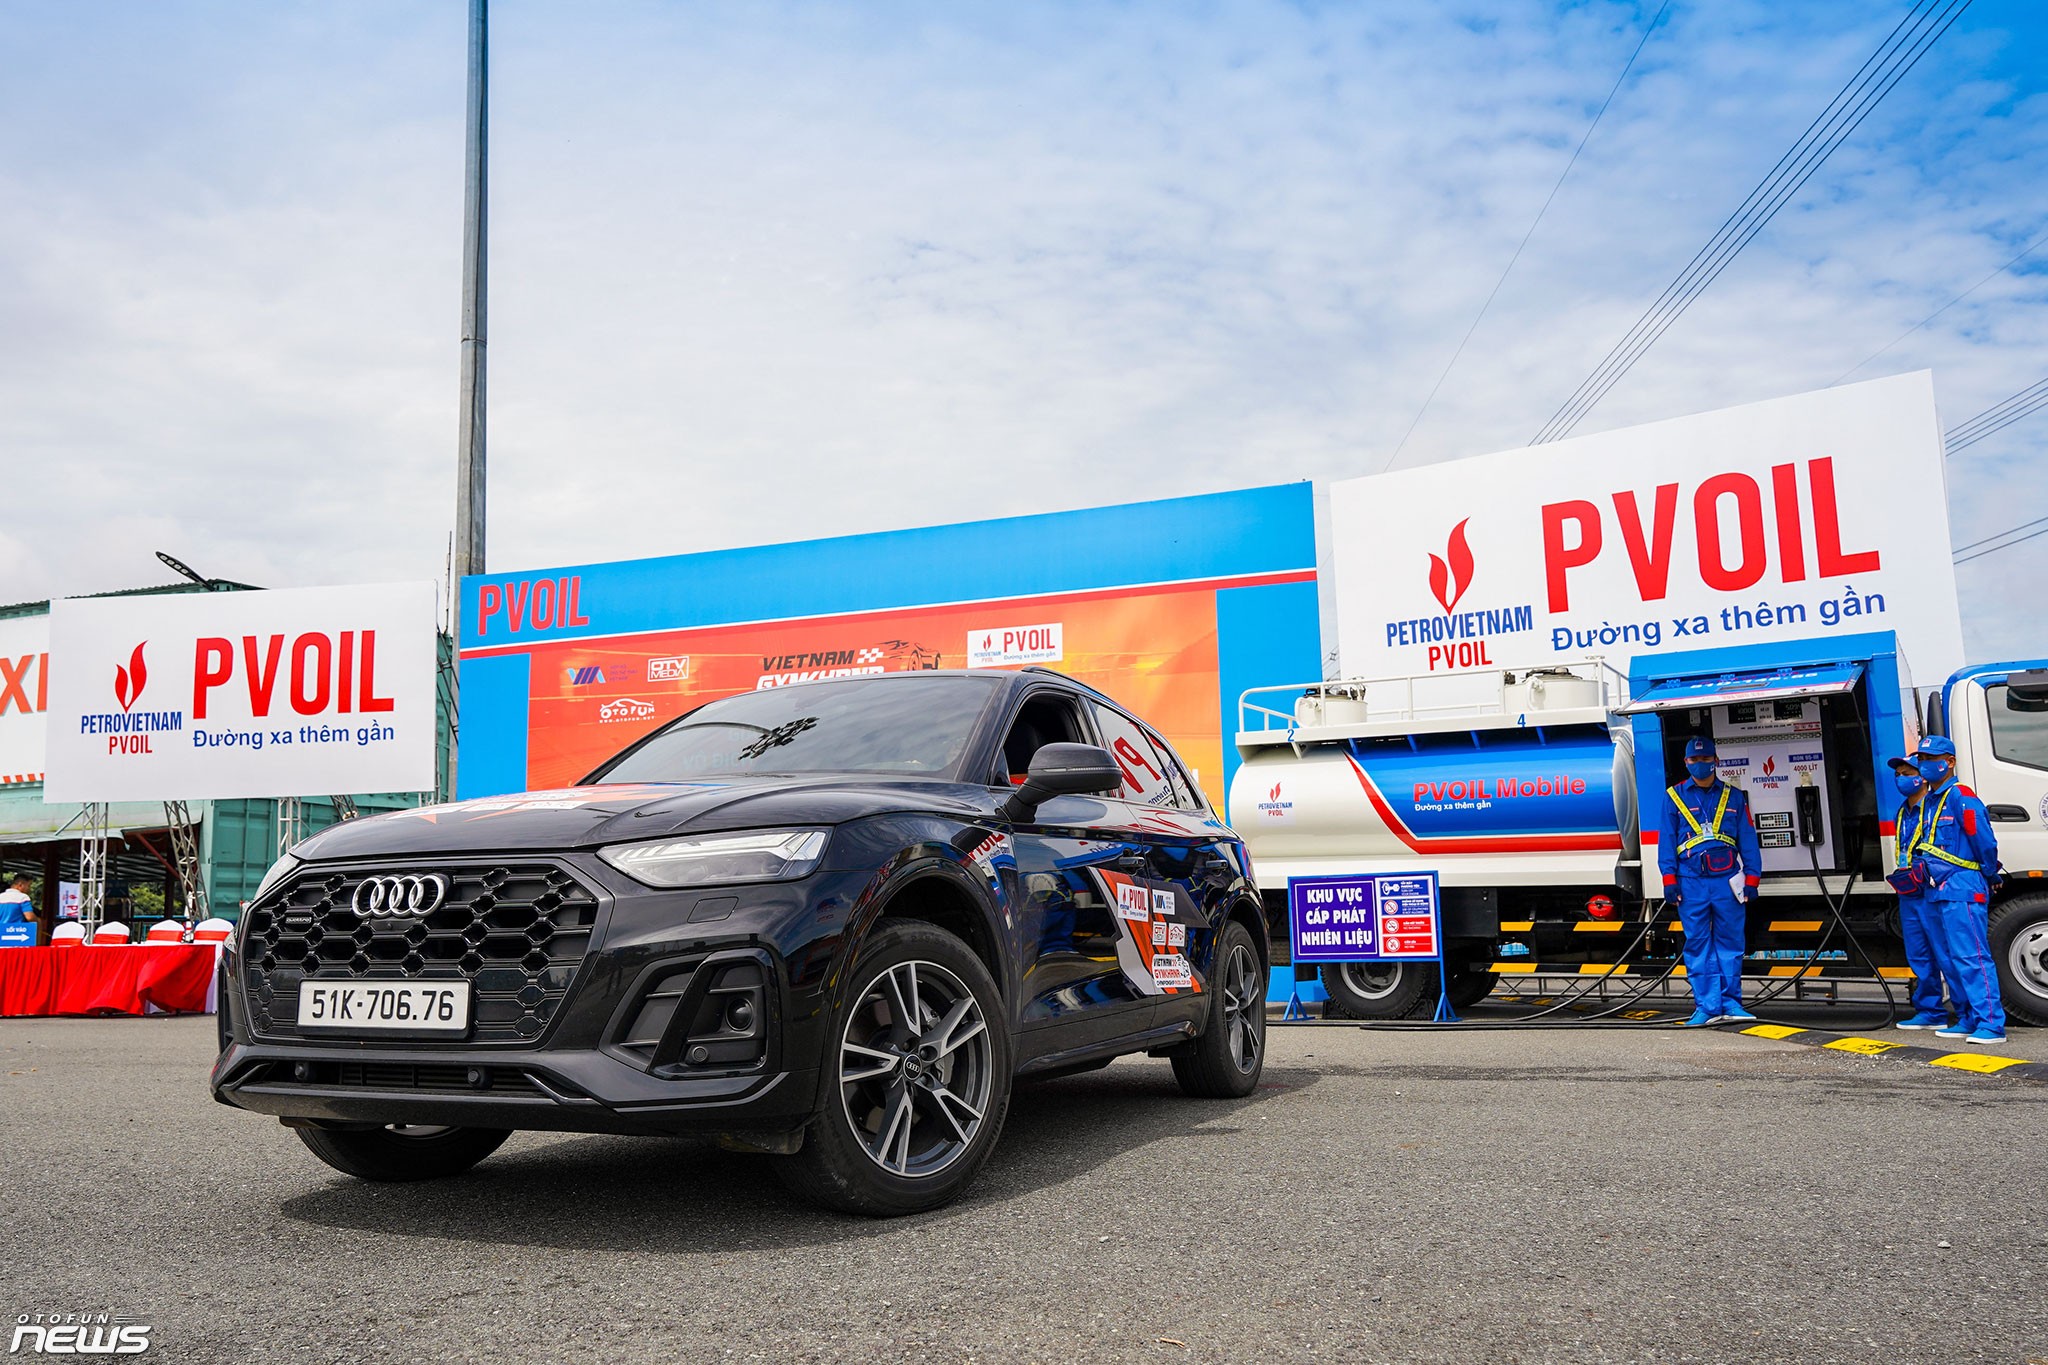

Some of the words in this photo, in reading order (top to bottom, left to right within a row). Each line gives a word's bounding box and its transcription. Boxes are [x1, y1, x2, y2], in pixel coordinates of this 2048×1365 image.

[1541, 456, 1881, 615] PVOIL
[478, 576, 590, 636] PVOIL
[1386, 605, 1534, 648] PETROVIETNAM
[1551, 615, 1662, 652] Đường
[1673, 613, 1711, 637] xa
[1720, 599, 1807, 631] thêm
[1819, 585, 1886, 626] gần
[1004, 628, 1055, 653] PVOIL
[763, 650, 855, 671] VIETNAM
[1428, 640, 1492, 672] PVOIL
[193, 630, 394, 719] PVOIL
[651, 669, 686, 679] MEDIA
[81, 711, 182, 734] PETROVIETNAM
[1517, 713, 1526, 728] 4
[108, 734, 153, 755] PVOIL
[193, 730, 263, 749] Đường
[270, 731, 292, 745] xa
[299, 725, 350, 745] thêm
[357, 719, 395, 746] gần
[1287, 728, 1295, 742] 2
[1413, 780, 1492, 802] PVOIL
[1496, 775, 1586, 798] Mobile
[1752, 775, 1789, 783] PETROVIETNAM
[1415, 802, 1442, 811] Đường
[1455, 801, 1475, 809] thêm
[1476, 799, 1491, 810] gần
[1307, 888, 1333, 903] KHU
[1336, 887, 1362, 906] VỰC
[1305, 906, 1330, 925] CẤP
[1333, 906, 1366, 924] PHÁT
[1301, 929, 1341, 946] NHIÊN
[1345, 927, 1373, 948] LIỆU
[311, 989, 455, 1021] 51K-706.76
